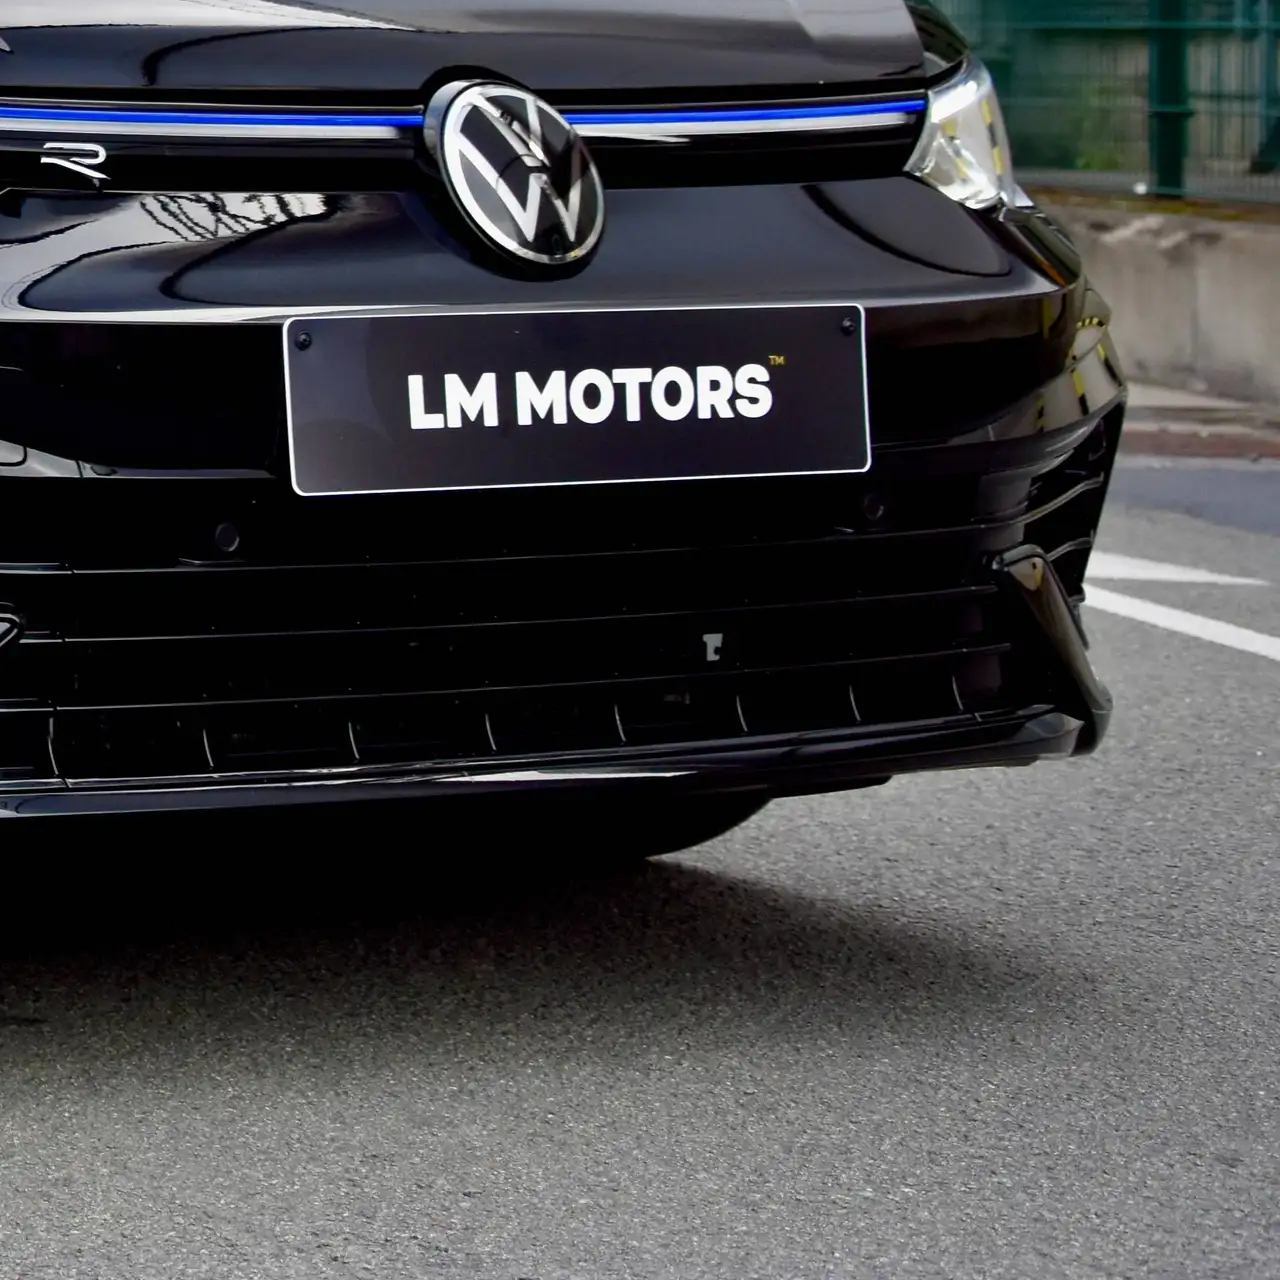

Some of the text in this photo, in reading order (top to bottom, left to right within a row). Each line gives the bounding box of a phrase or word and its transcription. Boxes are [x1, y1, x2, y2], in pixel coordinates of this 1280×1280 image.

[40, 142, 109, 180] R
[408, 372, 499, 429] LM
[515, 363, 773, 426] MOTORS
